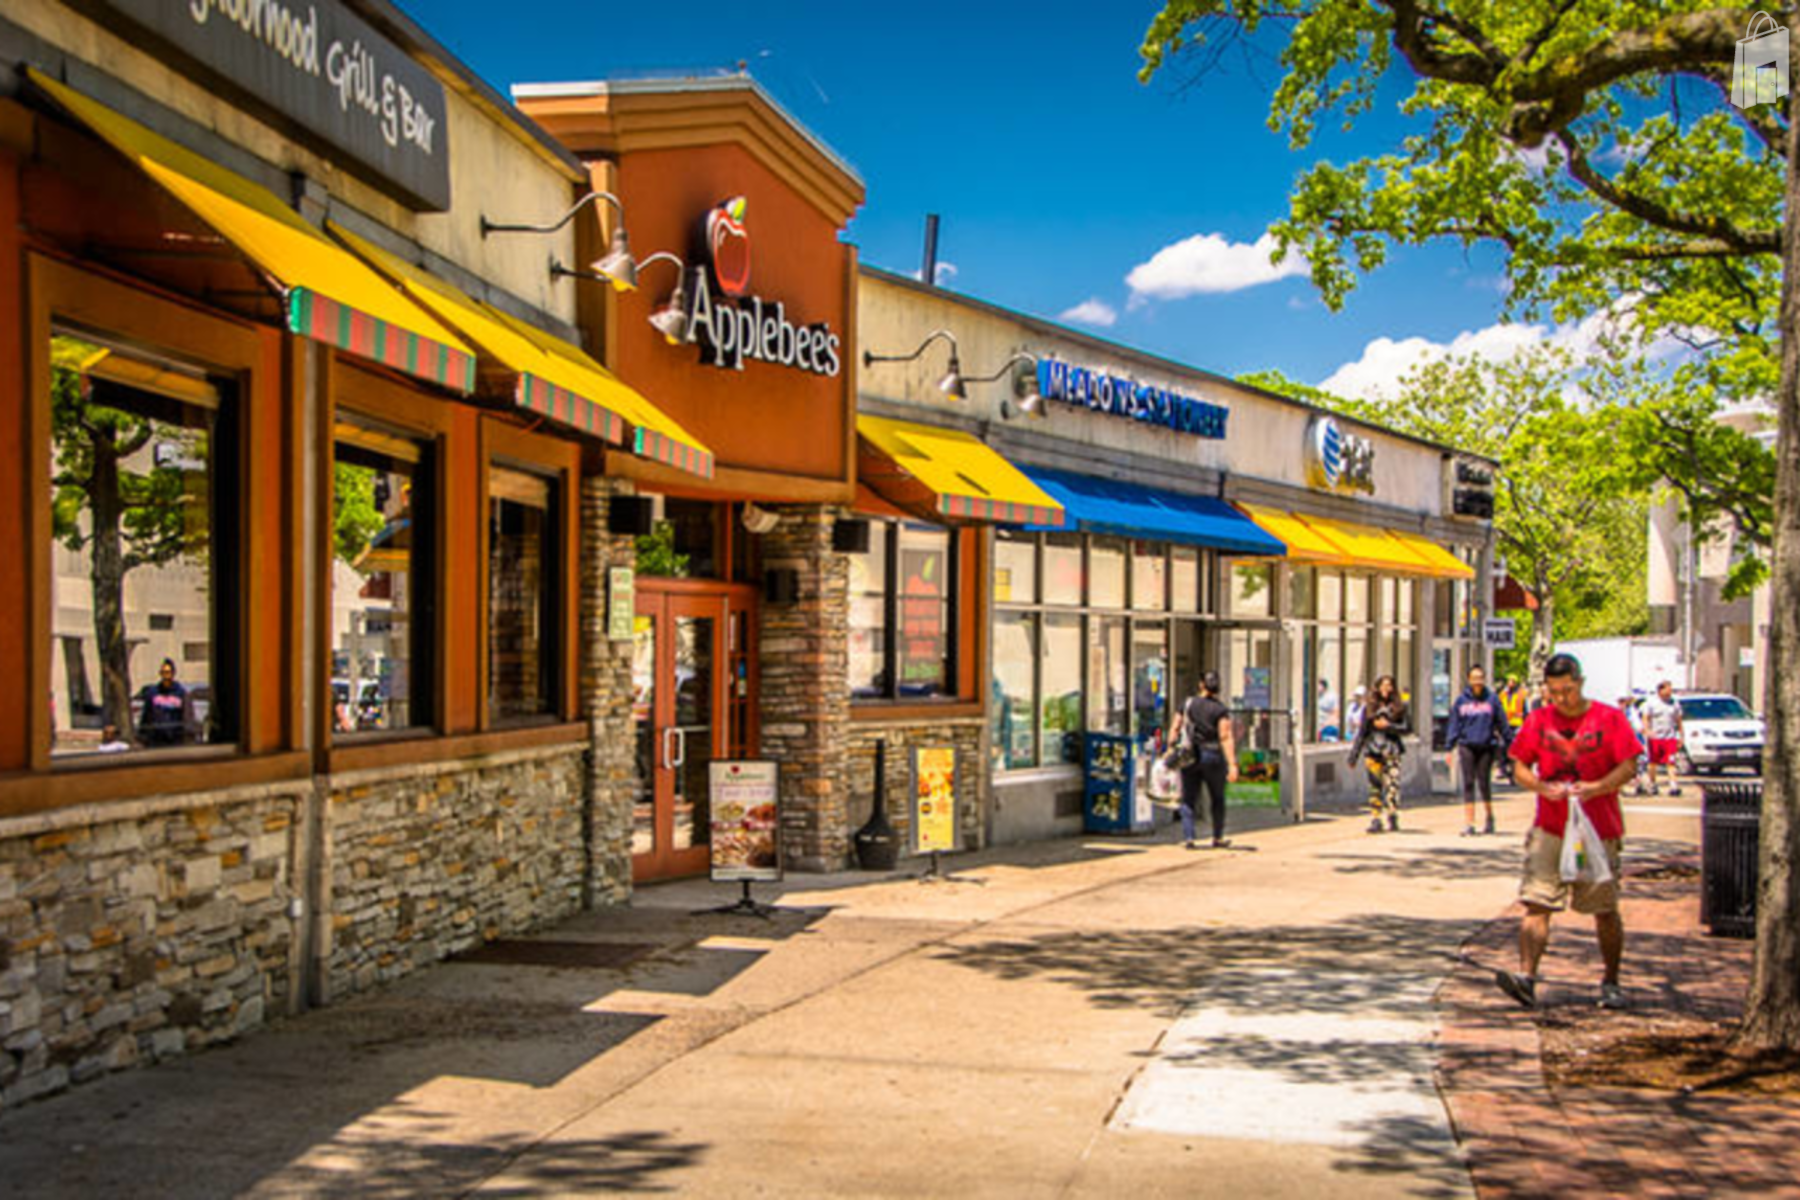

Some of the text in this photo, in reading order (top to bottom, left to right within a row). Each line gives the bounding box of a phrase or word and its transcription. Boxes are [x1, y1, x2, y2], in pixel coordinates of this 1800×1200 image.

[190, 0, 435, 154] orhood Grill & Bar
[686, 264, 840, 376] Applebee's
